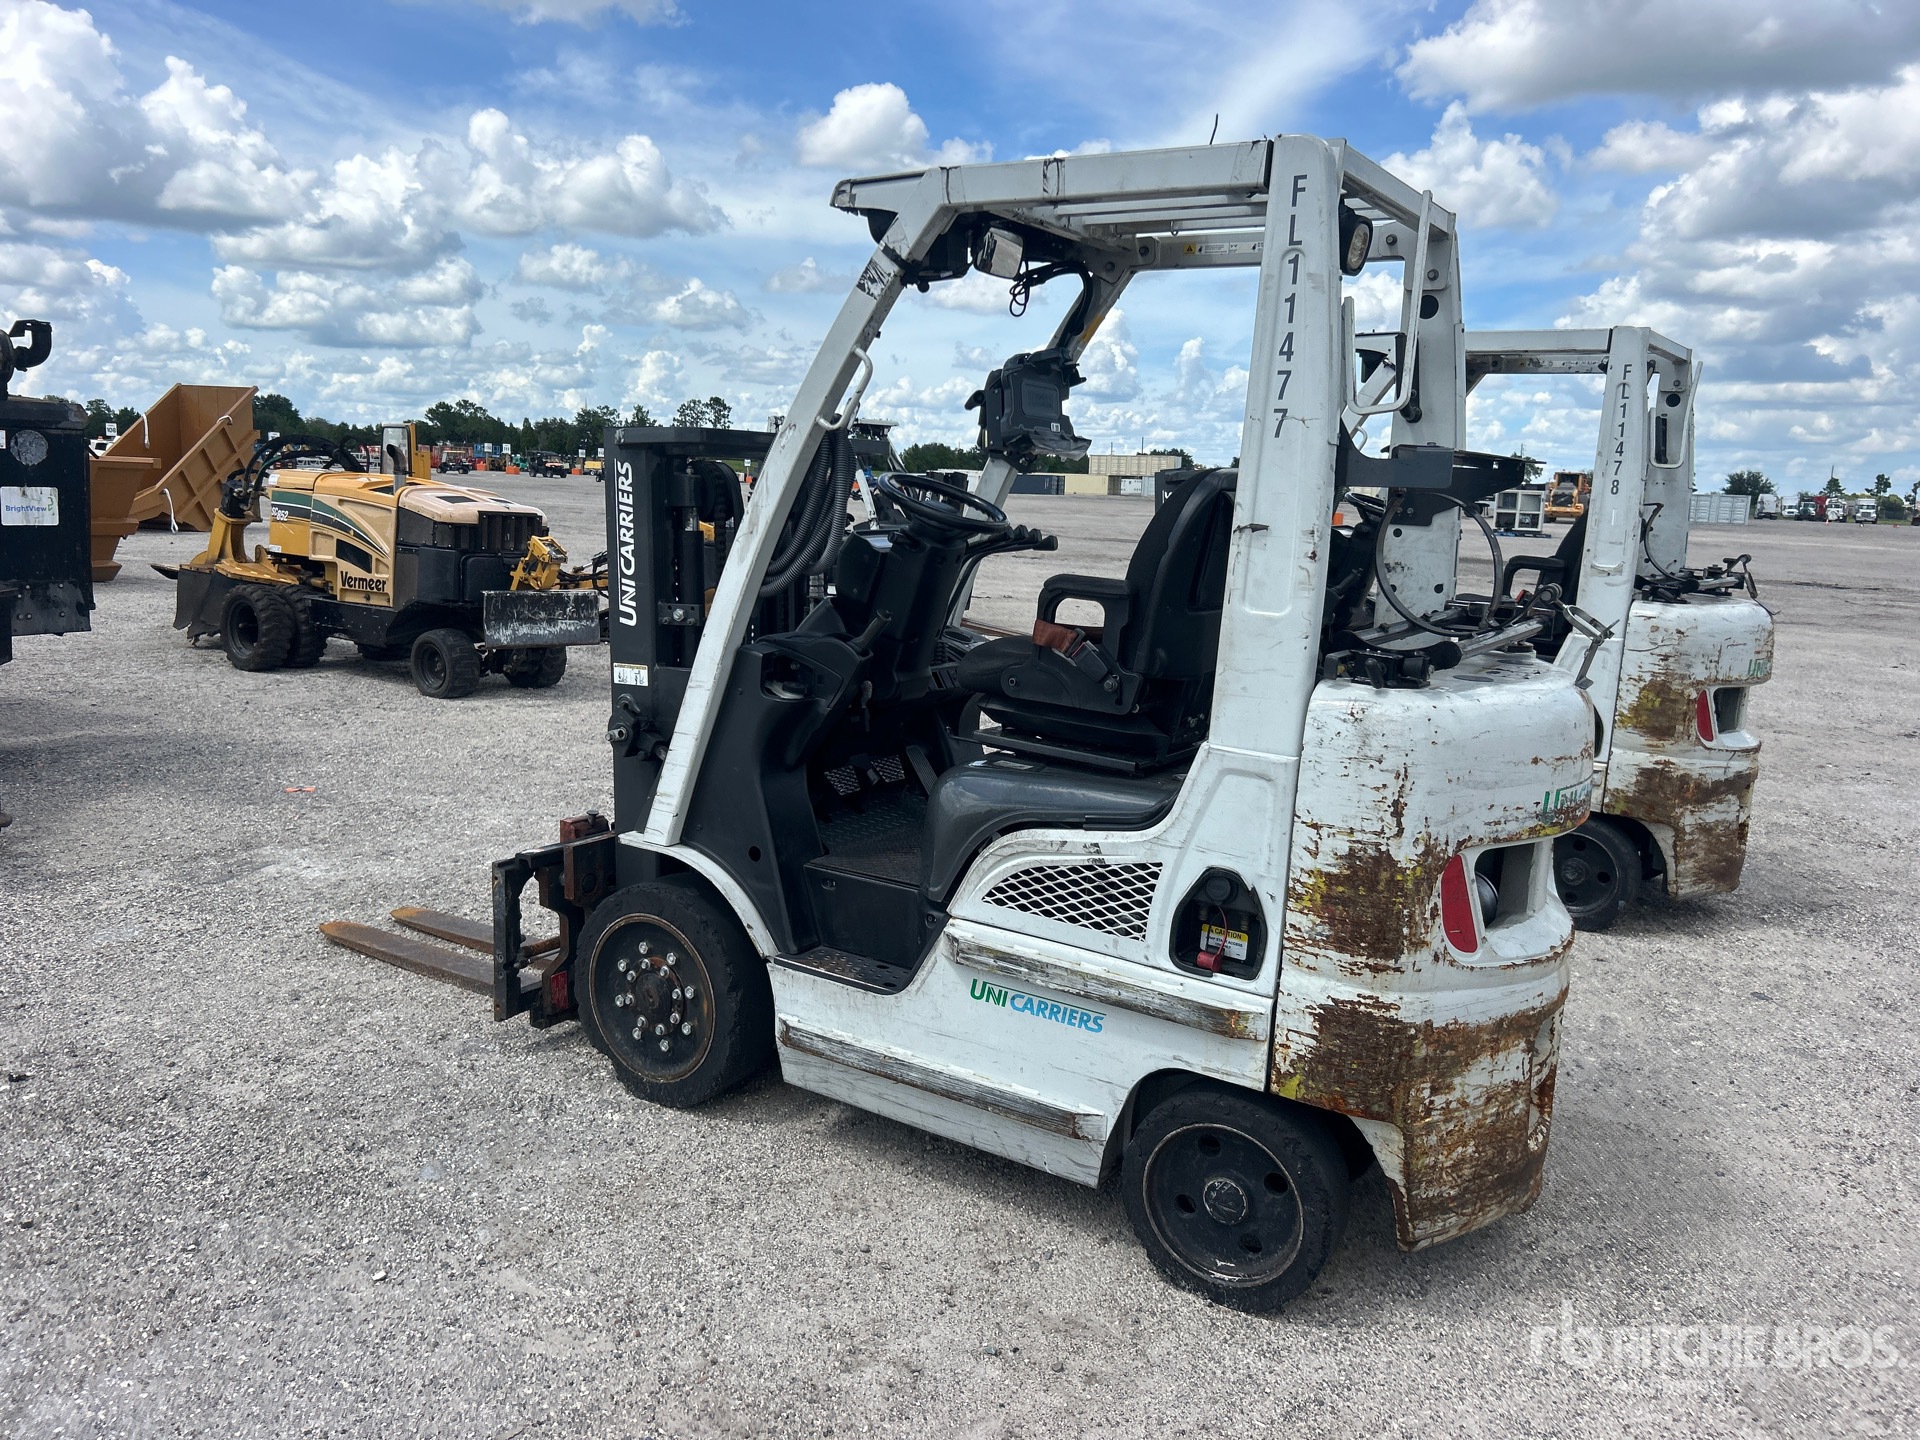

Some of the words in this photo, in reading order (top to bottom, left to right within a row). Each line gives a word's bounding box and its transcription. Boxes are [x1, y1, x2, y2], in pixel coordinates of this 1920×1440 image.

[1273, 174, 1308, 439] FL11477
[1610, 363, 1633, 496] FL11478
[5, 505, 47, 513] BrightView
[340, 570, 387, 592] Vermeer
[969, 978, 1105, 1034] UNICARRIERS
